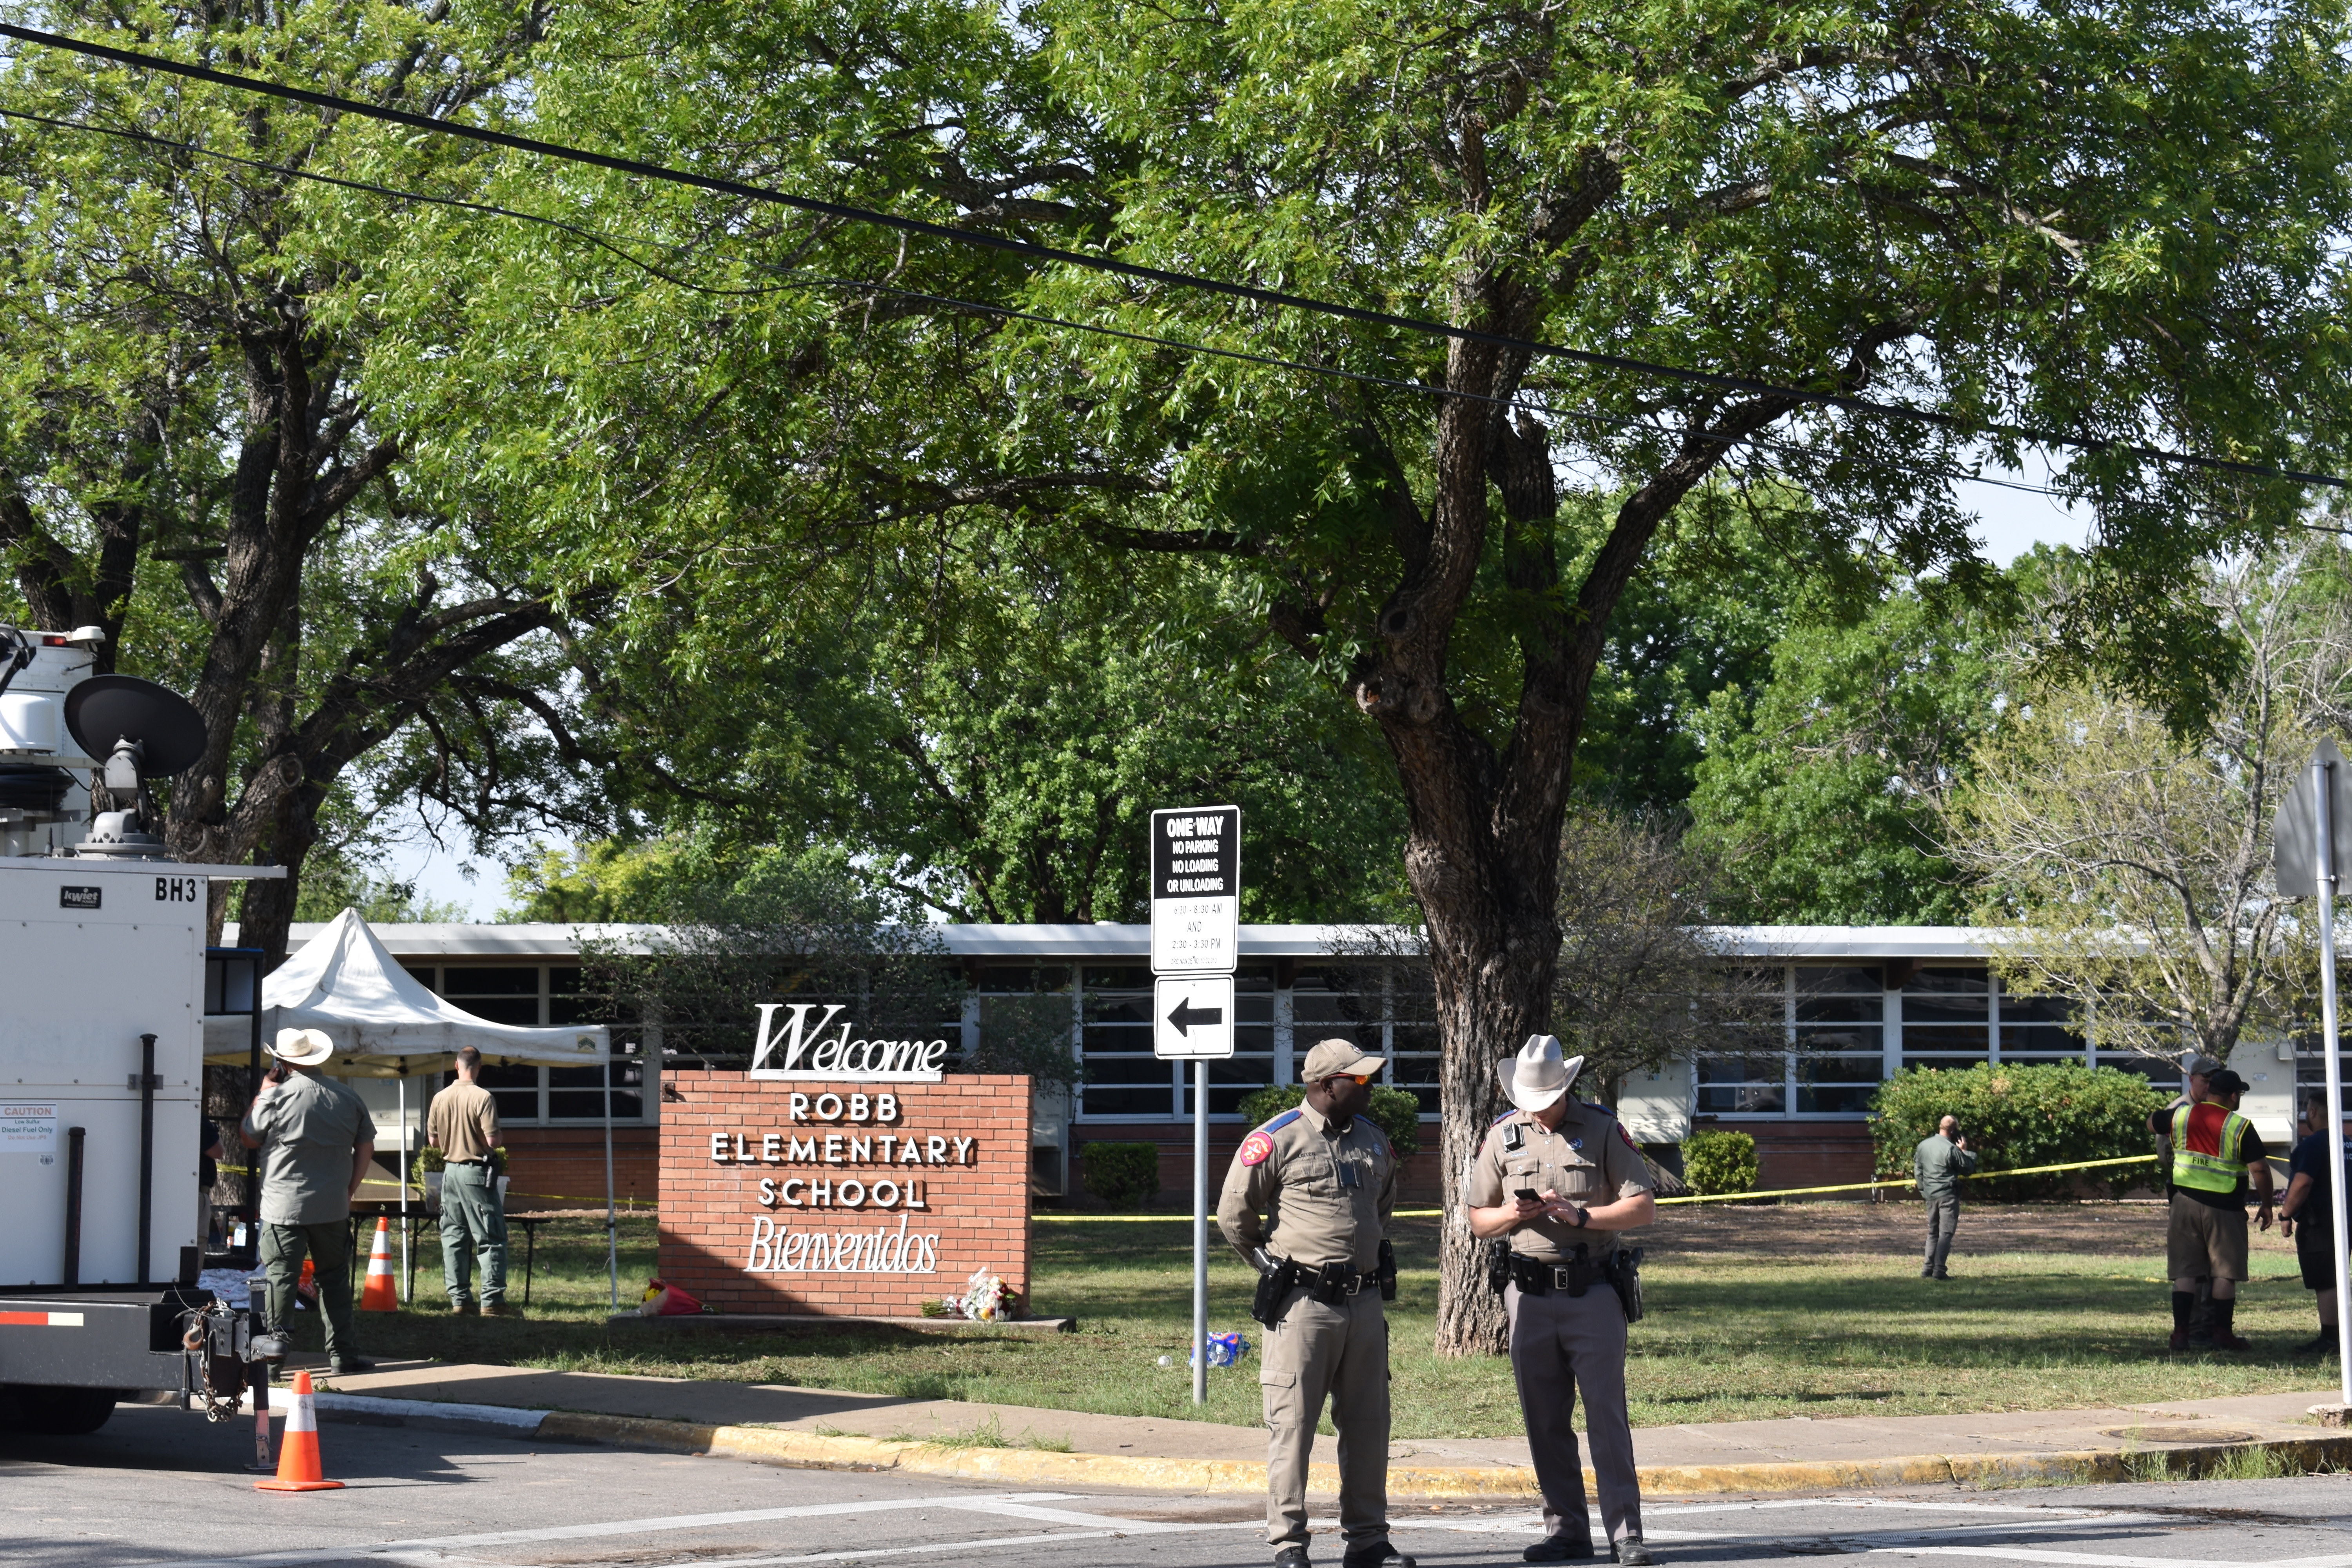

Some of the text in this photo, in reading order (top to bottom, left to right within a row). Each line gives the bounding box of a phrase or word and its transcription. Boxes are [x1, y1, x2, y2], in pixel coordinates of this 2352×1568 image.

[1167, 816, 1224, 838] ONE WAY
[1172, 839, 1218, 854] NO PARKING
[1172, 858, 1218, 873] NO LOADING
[155, 877, 196, 902] BH3
[1167, 877, 1223, 893] OR UNLOADING
[64, 888, 98, 901] kwiet
[1174, 906, 1186, 914] 6:30
[1194, 905, 1209, 914] 8:30
[1211, 903, 1222, 914] AM
[1187, 921, 1201, 932] AND
[1172, 940, 1187, 949] 2:30
[1194, 940, 1208, 948] 3:30
[1211, 938, 1221, 949] PM
[751, 1004, 947, 1073] Welcome
[4, 1107, 52, 1115] CAUTION
[789, 1093, 897, 1121] ROBB
[710, 1132, 973, 1164] ELEMENTARY
[2192, 1156, 2209, 1166] FIRE
[759, 1178, 925, 1208] SCHOOL
[744, 1214, 939, 1272] Bienvenidos
